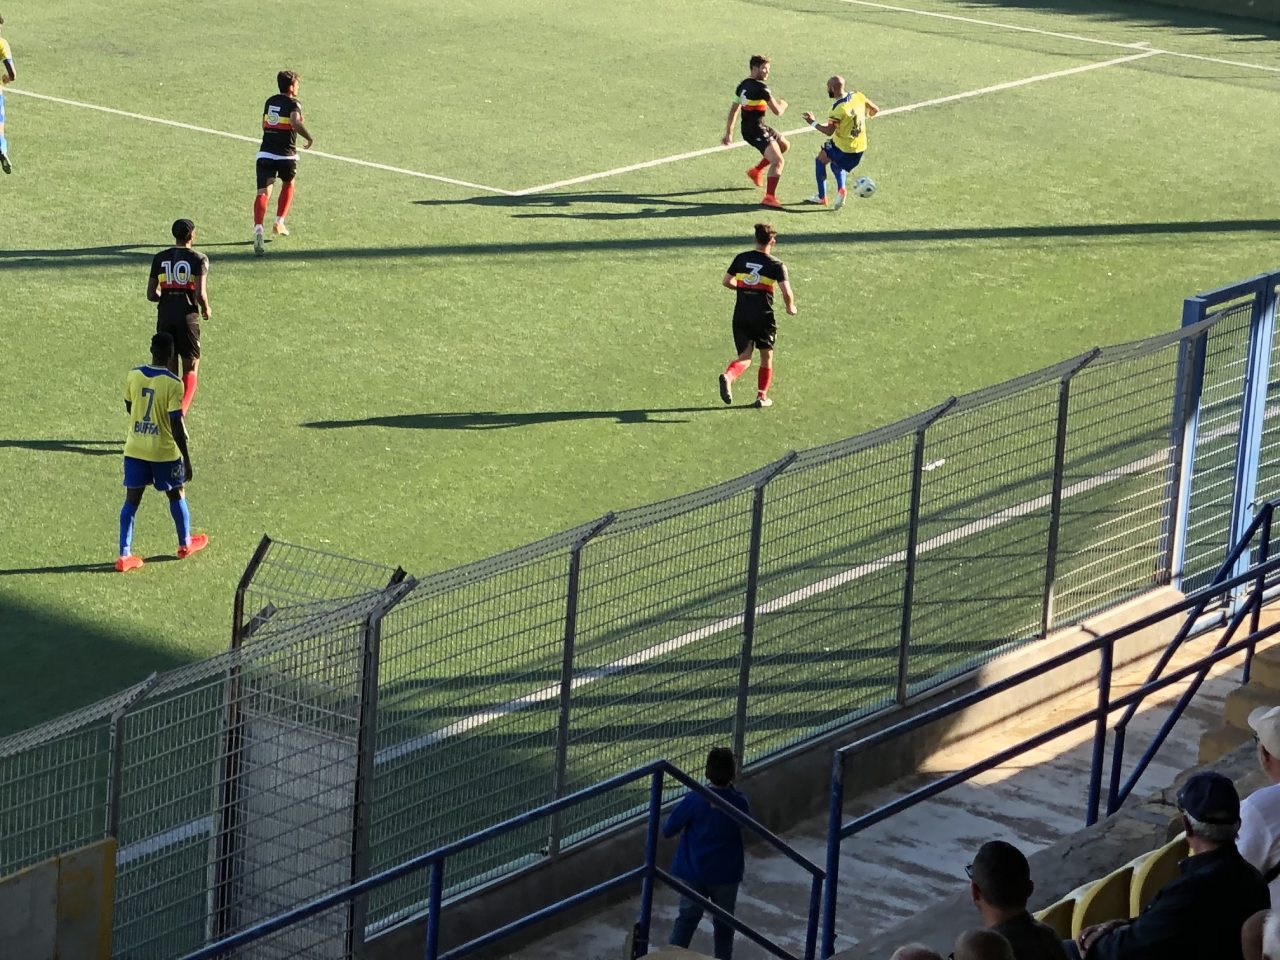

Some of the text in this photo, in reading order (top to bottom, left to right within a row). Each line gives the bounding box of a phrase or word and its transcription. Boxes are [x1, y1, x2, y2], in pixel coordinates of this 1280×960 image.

[267, 105, 280, 126] 5
[161, 260, 192, 285] 10
[743, 262, 763, 285] 3
[141, 387, 155, 421] 7
